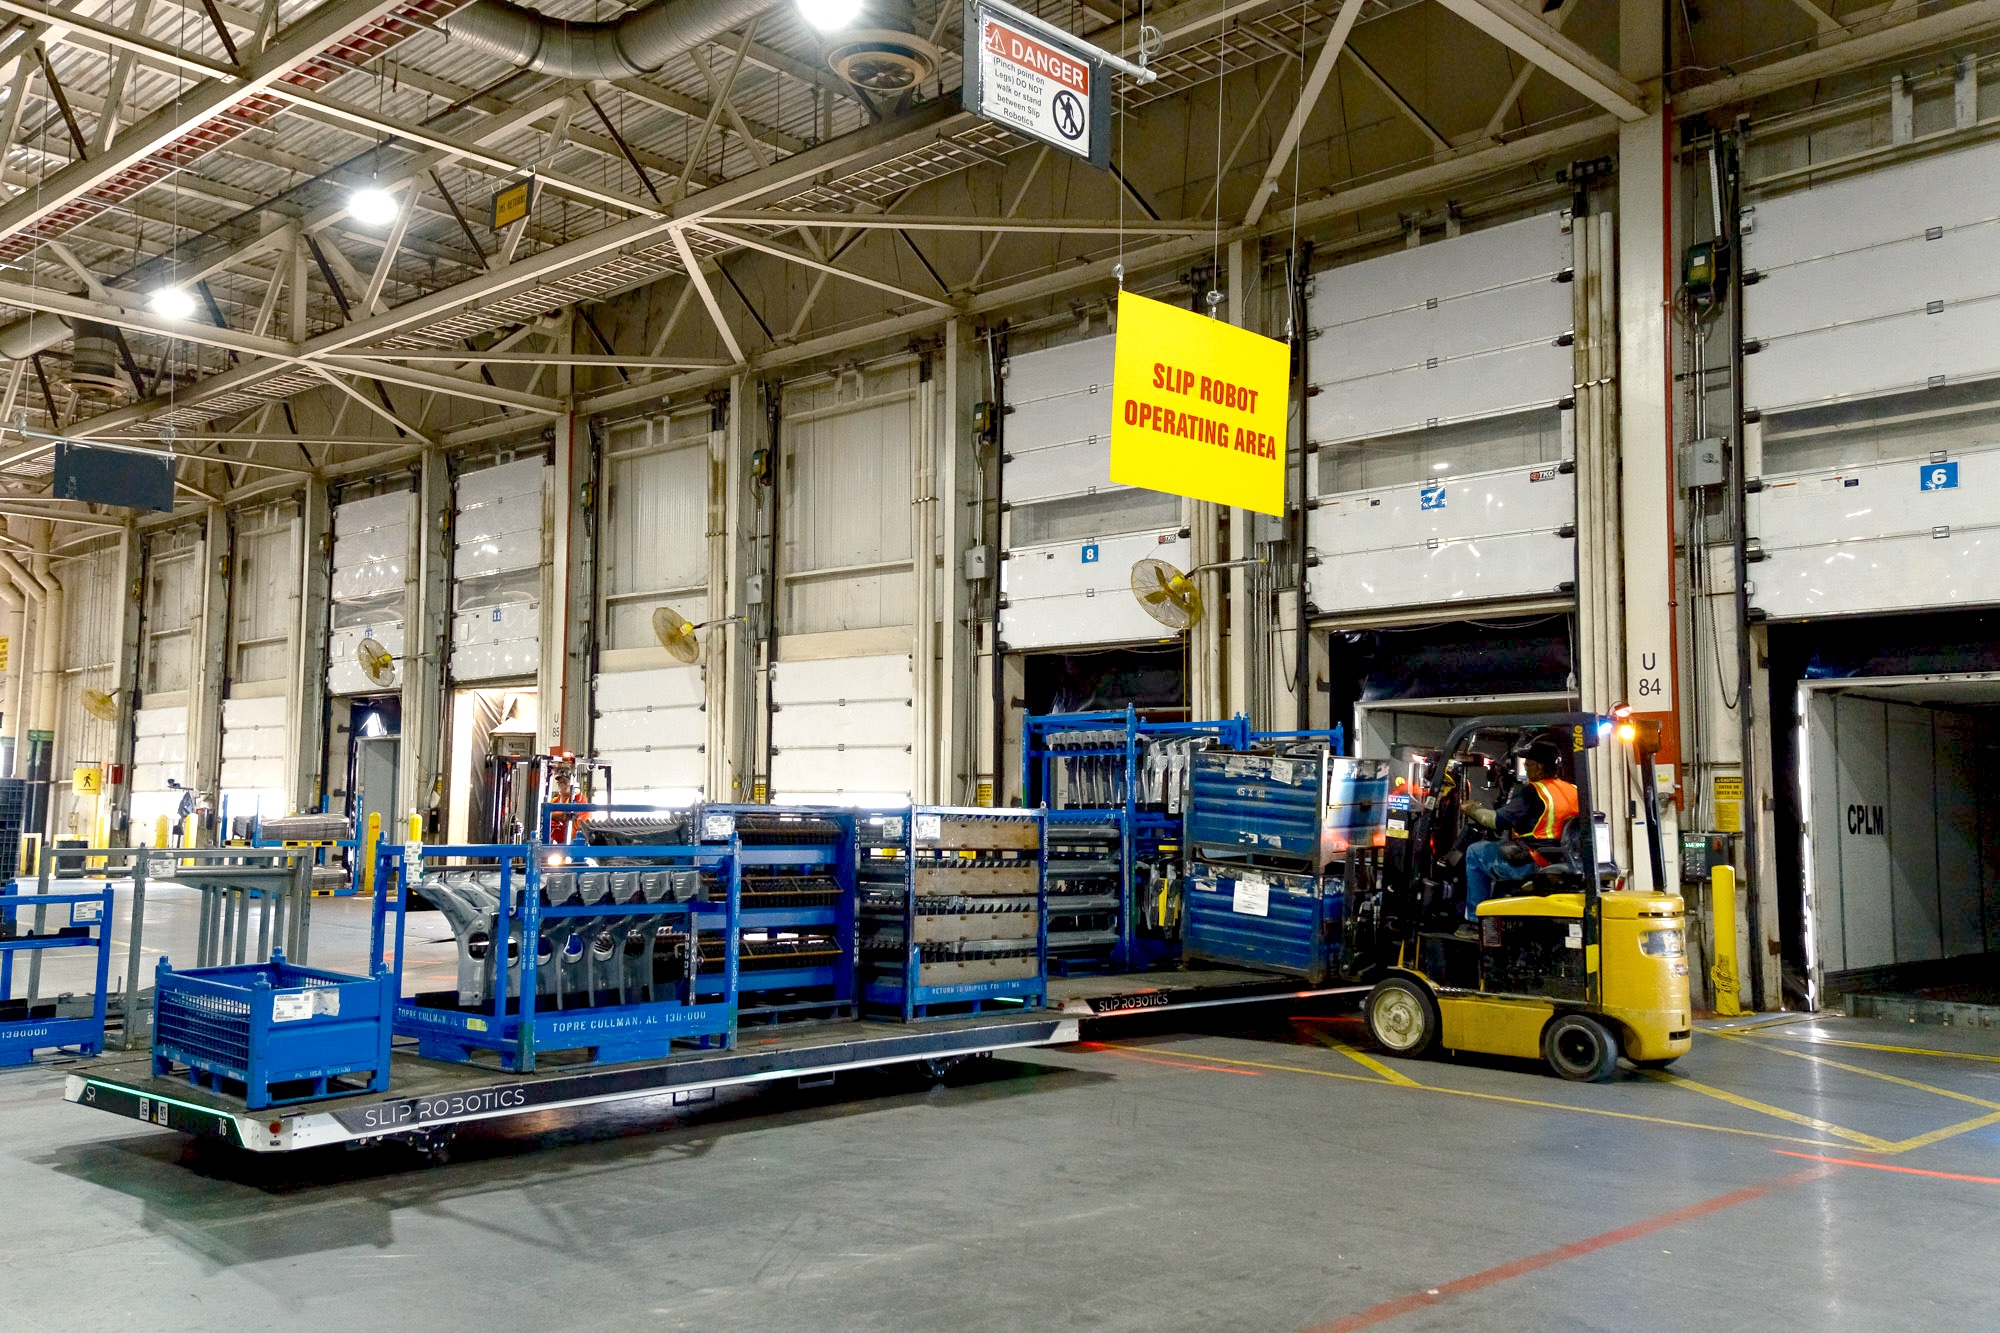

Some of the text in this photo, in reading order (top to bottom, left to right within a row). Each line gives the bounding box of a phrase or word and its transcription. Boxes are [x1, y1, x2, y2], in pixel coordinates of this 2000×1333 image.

[993, 56, 1045, 86] (Pinch point on
[1011, 37, 1085, 89] DANGER
[994, 68, 1043, 96] Legs) DO NOT
[996, 81, 1042, 107] walk or stand
[997, 93, 1041, 118] between Slip
[1003, 107, 1034, 127] Robotics
[1153, 362, 1259, 414] SLIP ROBOT
[1124, 399, 1277, 460] OPERATING AREA
[1931, 468, 1947, 485] 6
[1086, 548, 1094, 560] 8
[1642, 652, 1656, 671] U
[1638, 678, 1662, 697] 84
[554, 713, 560, 723] U
[1572, 725, 1584, 753] Yale
[1847, 804, 1884, 835] CPLM
[932, 986, 954, 995] RETURN
[1099, 993, 1169, 1012] SLIP ROBOTICS
[553, 1020, 587, 1032] TOPRE
[590, 1016, 642, 1030] CULLMAN,
[645, 1015, 658, 1024] AL
[365, 1088, 525, 1127] SLIP ROBOTICS
[218, 1117, 227, 1136] 76
